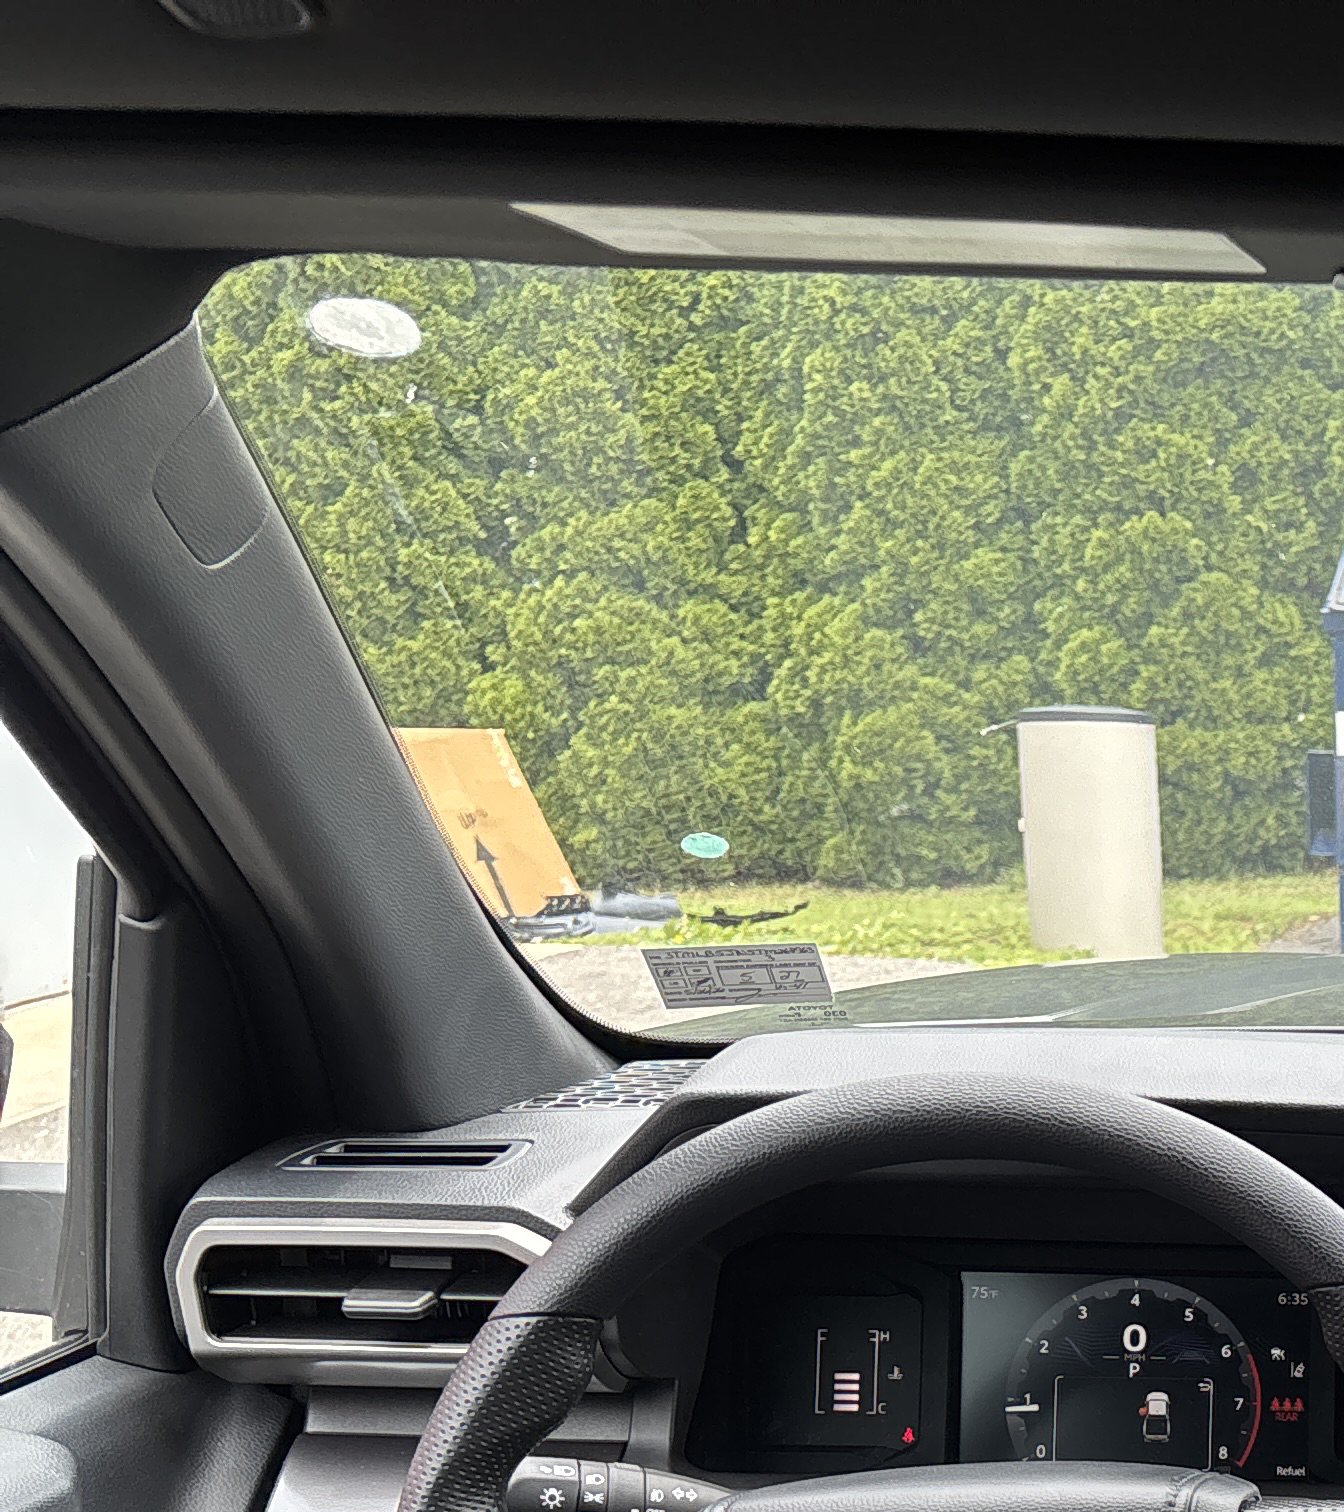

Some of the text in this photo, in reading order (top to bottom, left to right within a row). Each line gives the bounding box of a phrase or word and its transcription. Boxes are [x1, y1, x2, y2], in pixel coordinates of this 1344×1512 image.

[1130, 1293, 1141, 1308] 4
[1277, 1292, 1309, 1306] 6:35
[1078, 1306, 1088, 1320] 3
[1184, 1308, 1194, 1322] 5
[880, 1330, 890, 1342] H
[1122, 1323, 1148, 1353] 0
[1039, 1340, 1049, 1354] 2
[1221, 1344, 1232, 1358] 6
[1124, 1353, 1146, 1362] MPH
[1129, 1362, 1141, 1378] P
[1023, 1392, 1031, 1406] 1
[1234, 1397, 1244, 1411] 7
[878, 1402, 887, 1415] C
[1275, 1412, 1299, 1422] REAR
[1035, 1444, 1046, 1458] 0
[1218, 1445, 1228, 1459] 8
[1276, 1465, 1307, 1477] Refuel
